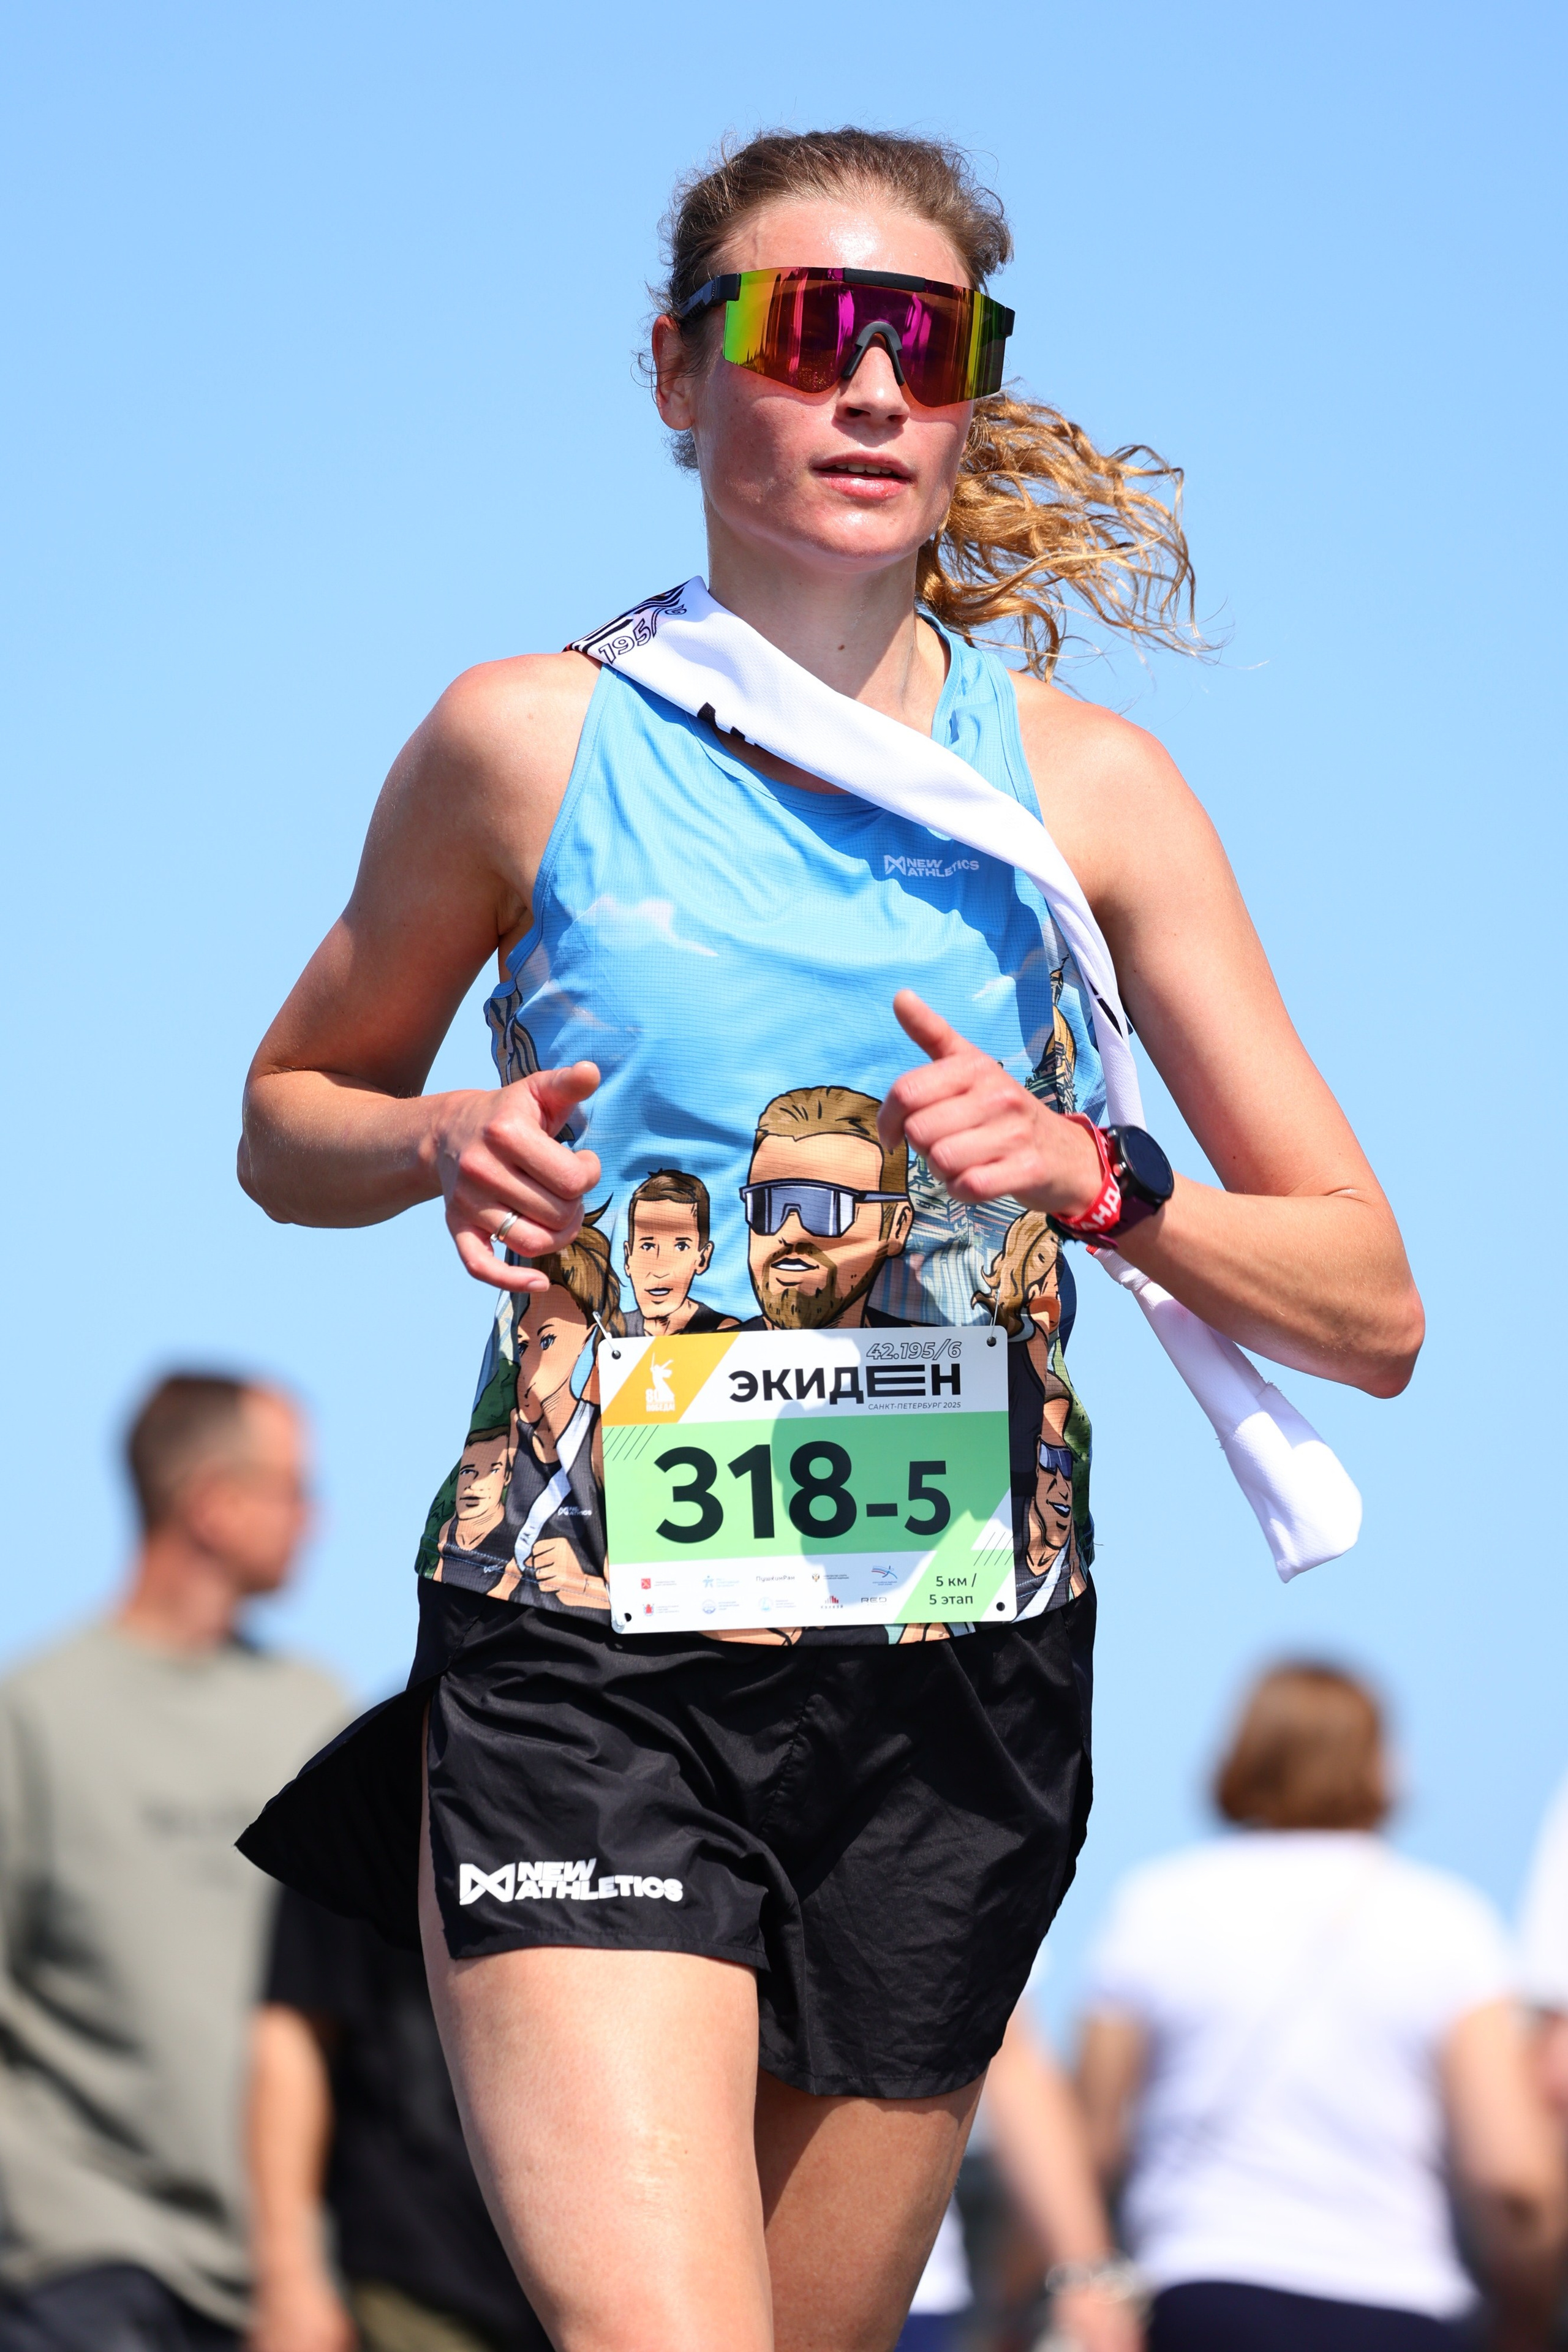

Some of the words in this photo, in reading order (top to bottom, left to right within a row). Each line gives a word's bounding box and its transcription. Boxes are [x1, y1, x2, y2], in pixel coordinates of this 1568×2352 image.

[906, 858, 943, 869] NEW
[907, 859, 980, 878] ATHLETICS
[866, 1339, 962, 1360] 42.195/6
[728, 1363, 961, 1404] ЭКИДЕН
[654, 1441, 951, 1544] 318-5
[936, 1576, 943, 1587] 5
[948, 1578, 967, 1586] км
[971, 1573, 977, 1587] /
[929, 1594, 937, 1605] 5
[941, 1596, 973, 1605] этап
[517, 1857, 597, 1882] NEW
[514, 1874, 684, 1902] ATHLETICS
